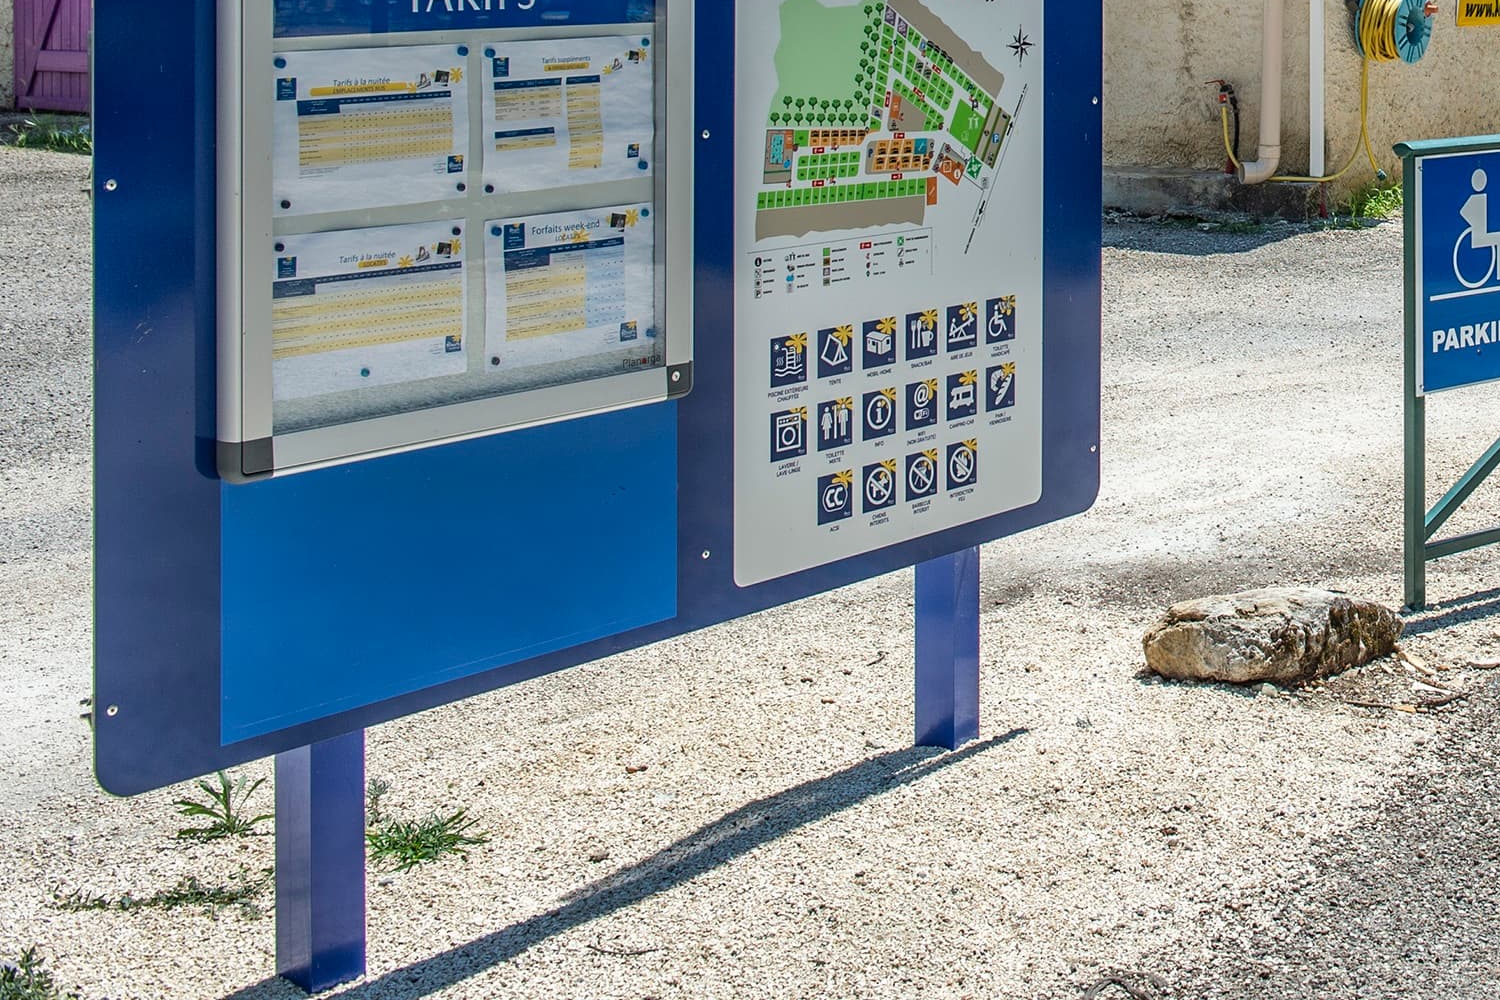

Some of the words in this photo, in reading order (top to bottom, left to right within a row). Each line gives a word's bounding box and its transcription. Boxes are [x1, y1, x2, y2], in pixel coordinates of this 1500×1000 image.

[333, 79, 352, 87] Tarifs
[532, 224, 562, 235] Forfaits
[564, 220, 600, 232] week-end
[340, 255, 359, 264] Tarifs
